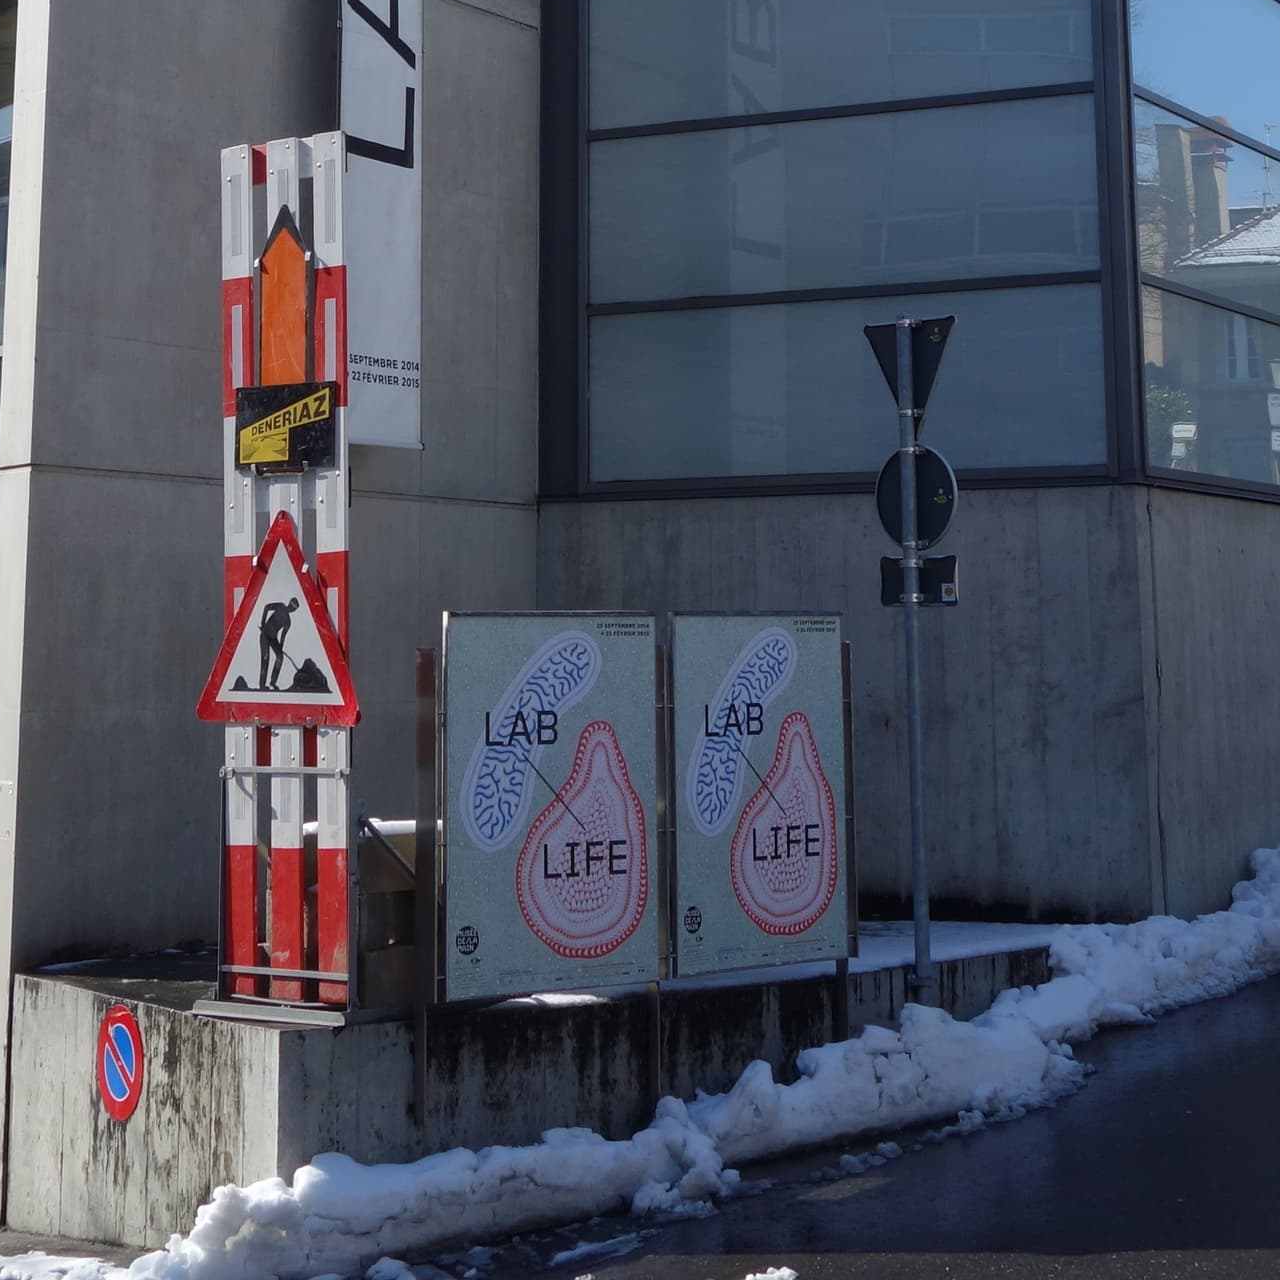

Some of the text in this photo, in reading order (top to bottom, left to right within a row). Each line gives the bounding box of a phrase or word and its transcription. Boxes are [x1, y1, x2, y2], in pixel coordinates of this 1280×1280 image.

[349, 353, 419, 372] SEPTEMBRE 2014
[352, 370, 420, 389] 22 FÉVRIER 2015
[251, 393, 327, 436] DENERIAZ
[485, 710, 559, 747] LAB
[704, 703, 764, 738] LAB
[543, 839, 628, 879] LIFE
[752, 824, 820, 862] LIFE
